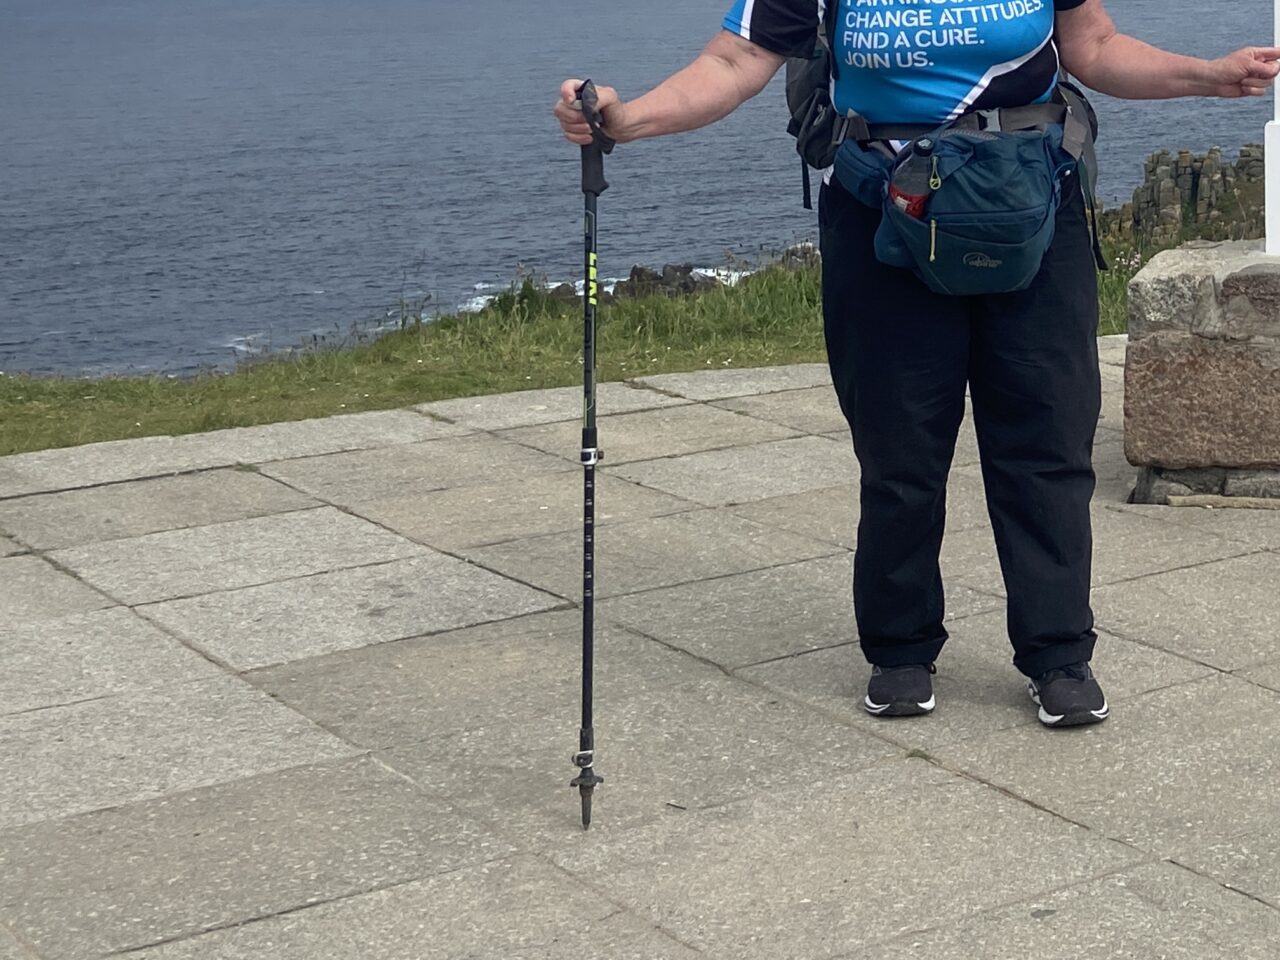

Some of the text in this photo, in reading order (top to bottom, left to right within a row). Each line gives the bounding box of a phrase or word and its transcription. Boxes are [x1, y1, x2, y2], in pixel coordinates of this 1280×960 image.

[845, 9, 933, 28] CHANGE
[843, 27, 985, 49] FIND A CURE.
[844, 51, 934, 69] JOIN US.
